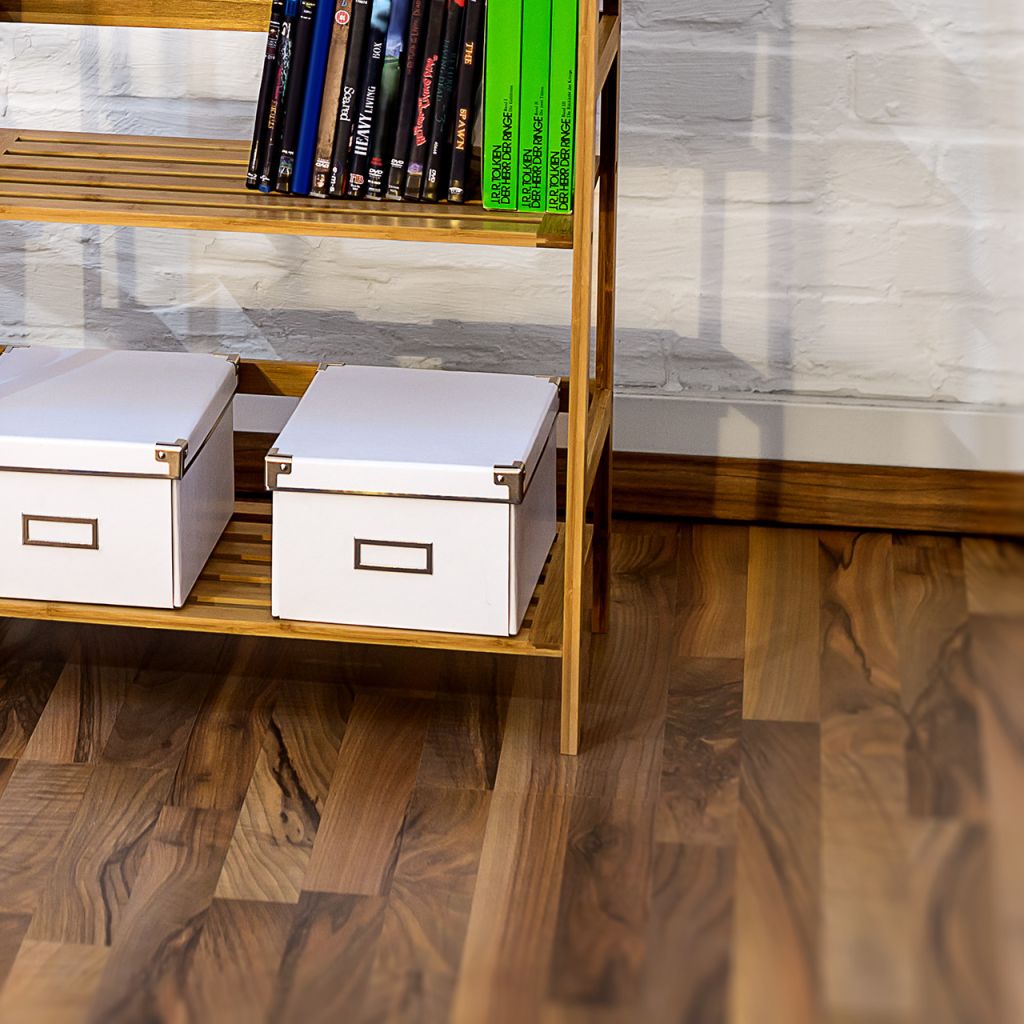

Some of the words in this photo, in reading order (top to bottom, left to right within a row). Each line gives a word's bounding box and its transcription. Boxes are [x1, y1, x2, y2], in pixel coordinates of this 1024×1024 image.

[372, 42, 382, 60] BOX
[464, 41, 473, 65] THE
[340, 86, 355, 122] Scared
[354, 112, 372, 156] HEAVY
[364, 86, 376, 114] LIVING
[455, 108, 467, 151] SPAWN
[502, 112, 512, 141] RINGE
[533, 116, 543, 145] RINGE
[561, 119, 570, 147] RINGE
[502, 142, 512, 160] DER
[533, 146, 542, 164] DER
[560, 148, 570, 166] DER
[492, 145, 501, 182] TOLKIEN
[501, 162, 511, 184] HERR
[522, 149, 532, 186] TOLKIEN
[550, 152, 559, 187] TOLKIEN
[532, 166, 542, 188] HERR
[560, 168, 569, 191] HERR
[501, 186, 510, 204] DER
[531, 190, 541, 208] DER
[559, 192, 568, 210] DER
